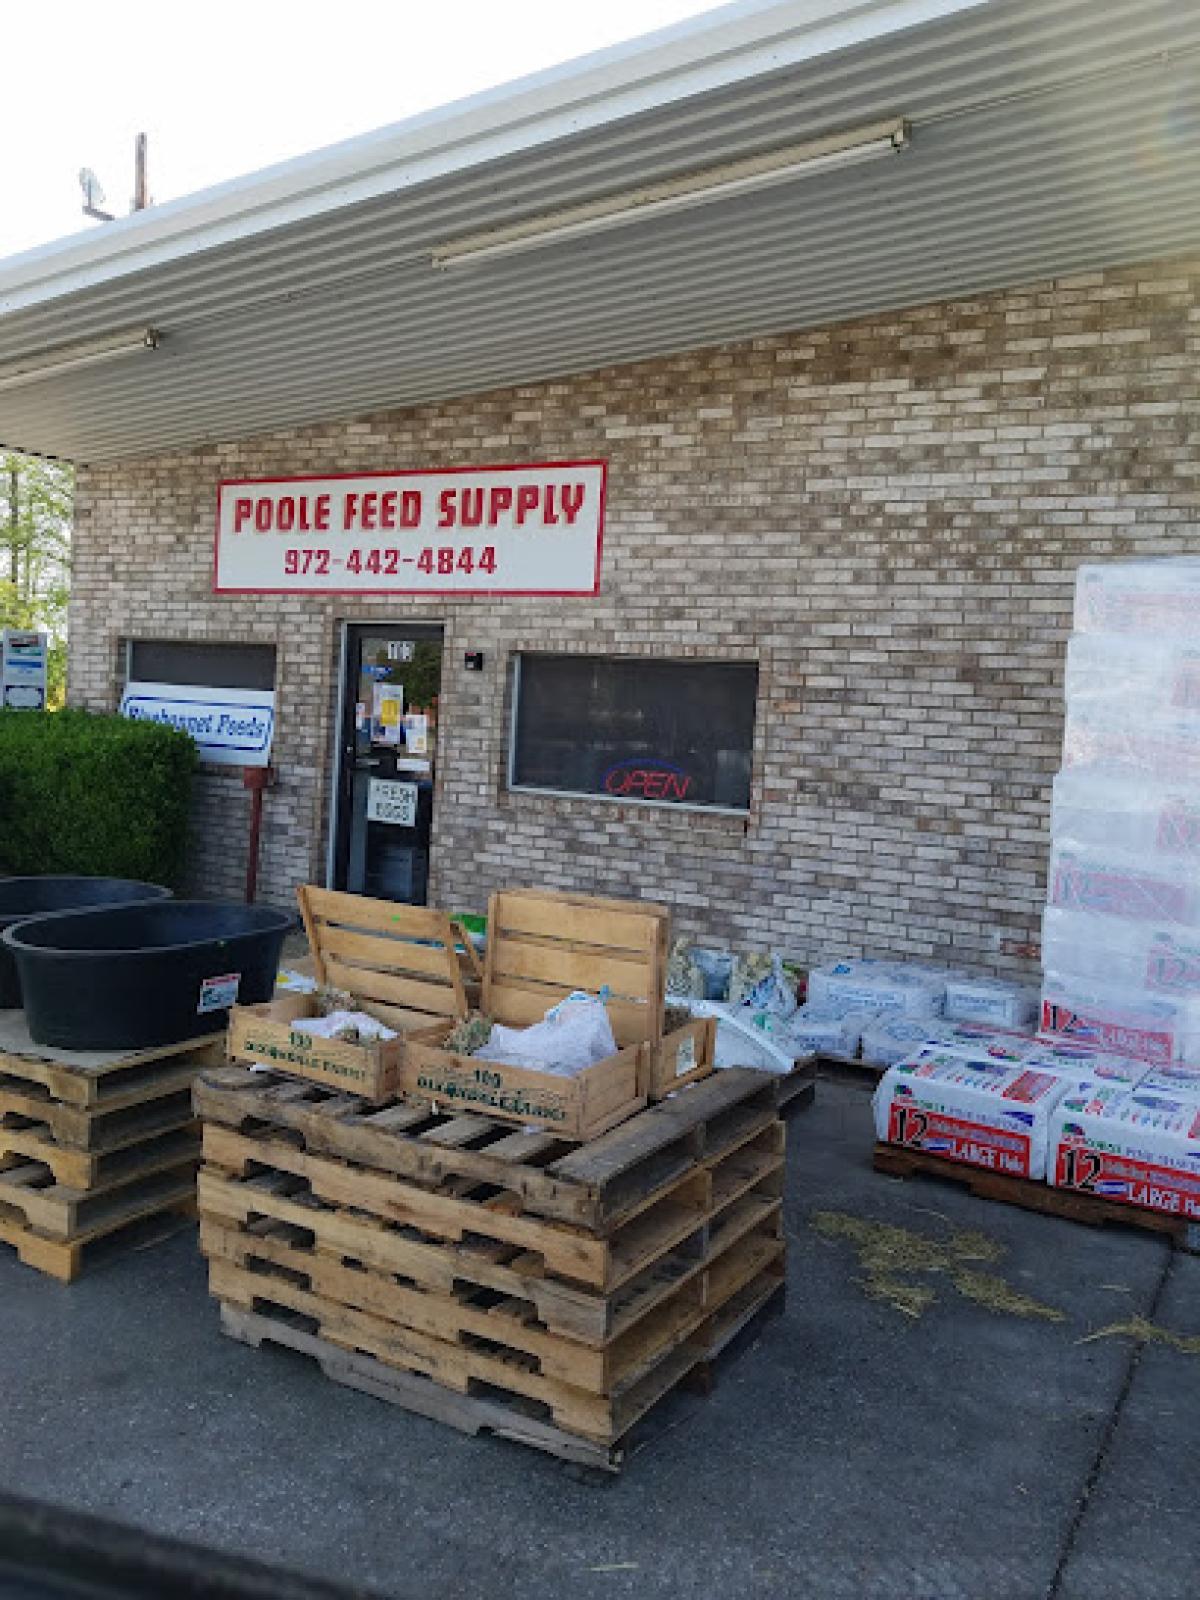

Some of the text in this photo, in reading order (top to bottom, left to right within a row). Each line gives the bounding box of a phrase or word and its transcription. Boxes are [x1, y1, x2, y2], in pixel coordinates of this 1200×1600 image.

[233, 483, 586, 533] POOLE FEED SUPPLY
[284, 546, 498, 575] 972-442-4844
[606, 770, 692, 798] OPEN
[893, 1109, 928, 1148] 12
[949, 1138, 997, 1168] LARGE
[1063, 1149, 1103, 1191] 12
[1126, 1184, 1180, 1213] LARGE
